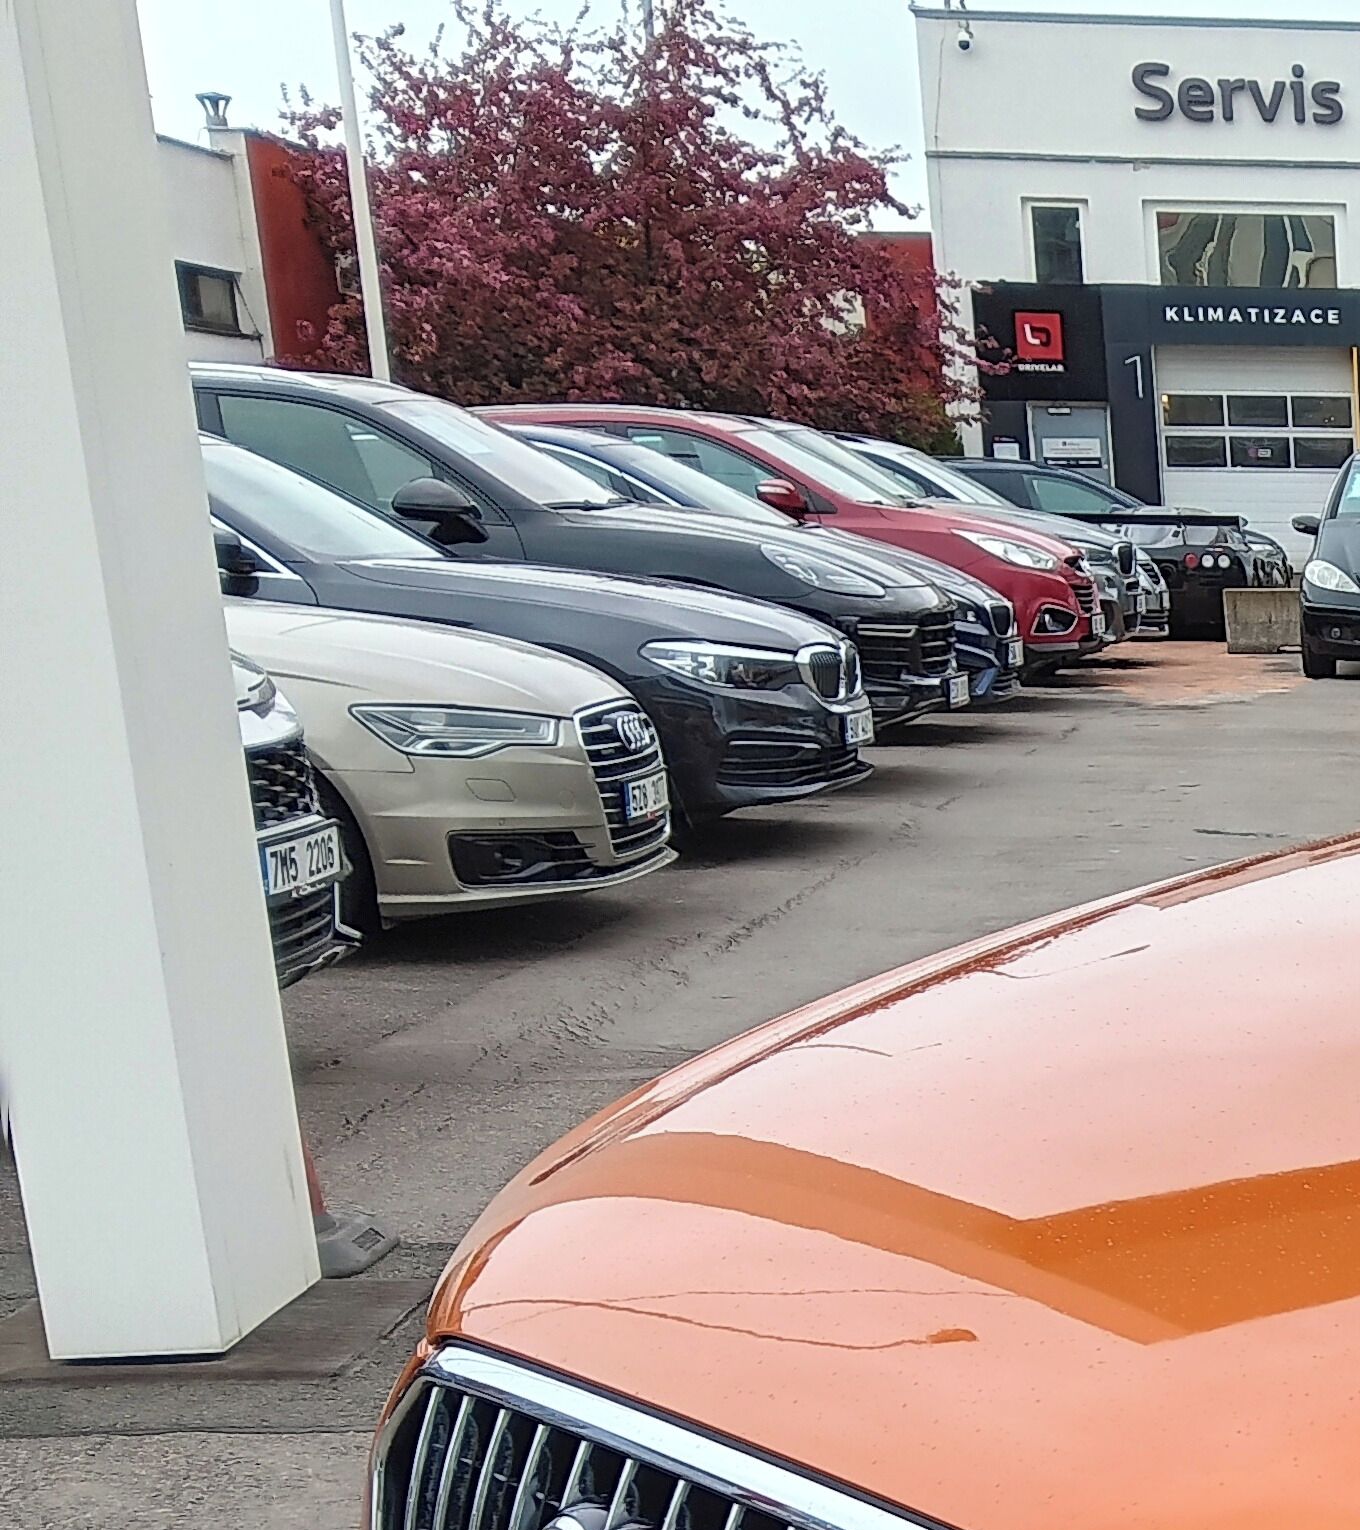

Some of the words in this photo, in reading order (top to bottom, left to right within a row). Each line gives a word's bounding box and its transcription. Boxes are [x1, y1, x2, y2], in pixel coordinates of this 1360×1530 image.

[1131, 62, 1343, 126] Servis
[1164, 306, 1341, 325] KLIMATIZACE
[1017, 363, 1065, 373] DRIVELAB
[1124, 355, 1144, 399] 1
[306, 833, 335, 878] 2206
